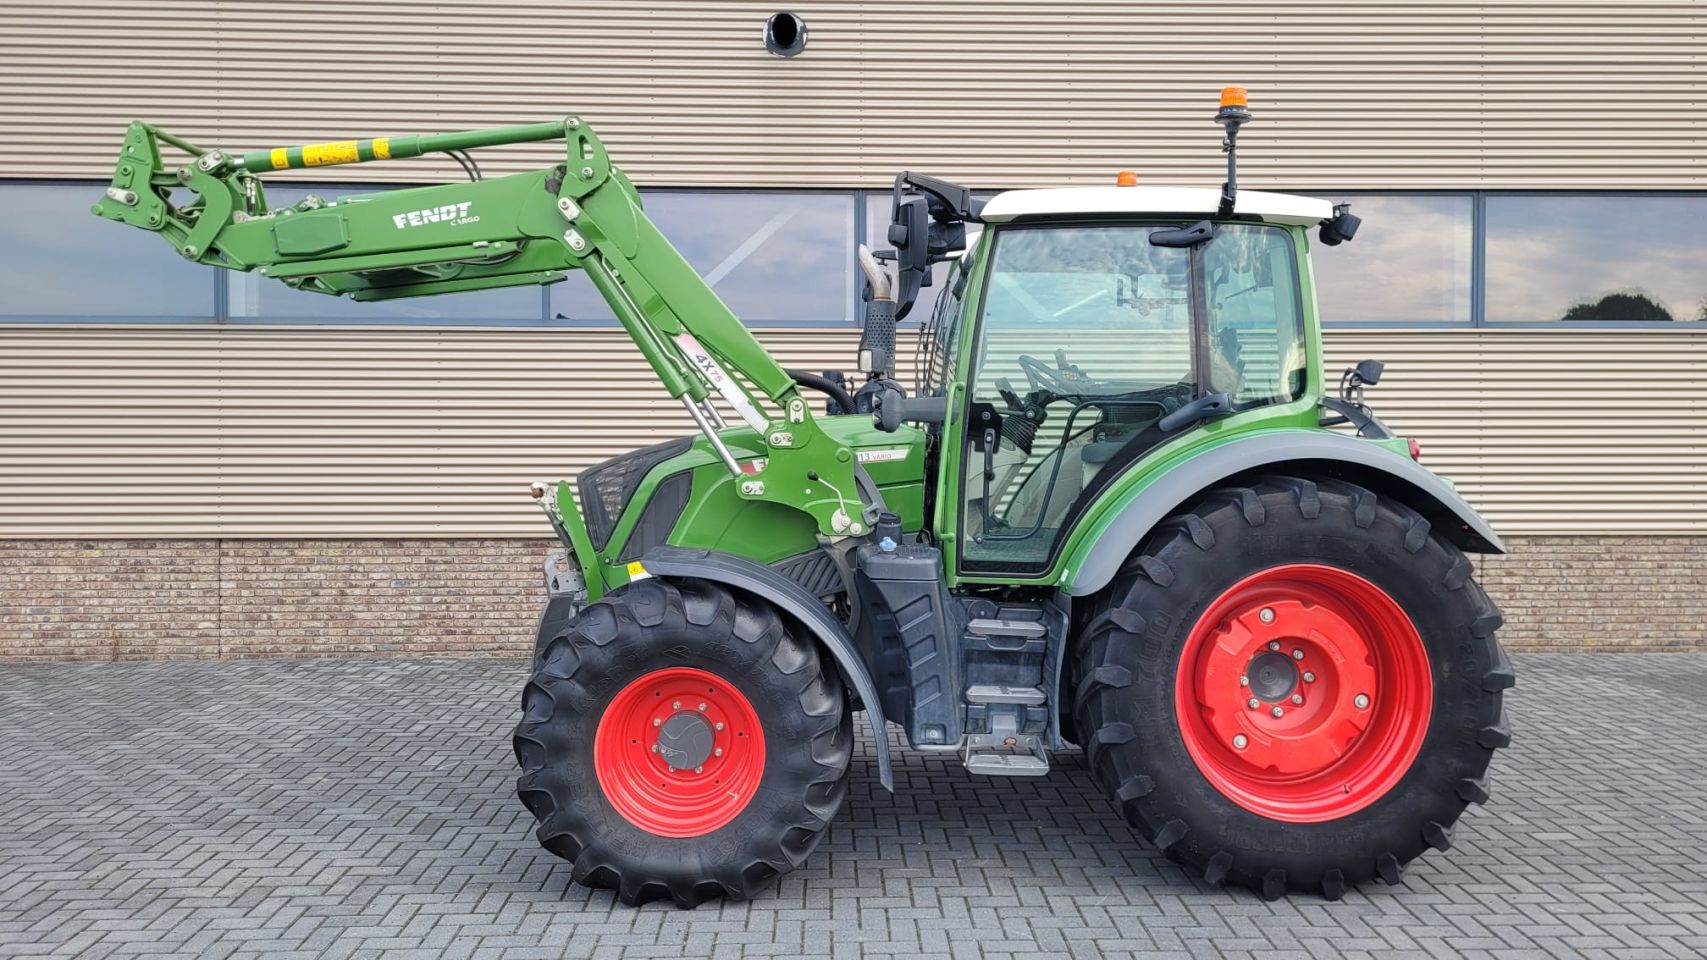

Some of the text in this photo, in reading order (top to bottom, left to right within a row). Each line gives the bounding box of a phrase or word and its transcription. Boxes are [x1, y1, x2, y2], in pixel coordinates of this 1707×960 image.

[392, 201, 472, 229] FENDT
[450, 216, 480, 226] CARGO
[696, 354, 724, 382] 4X75
[859, 453, 870, 462] 13
